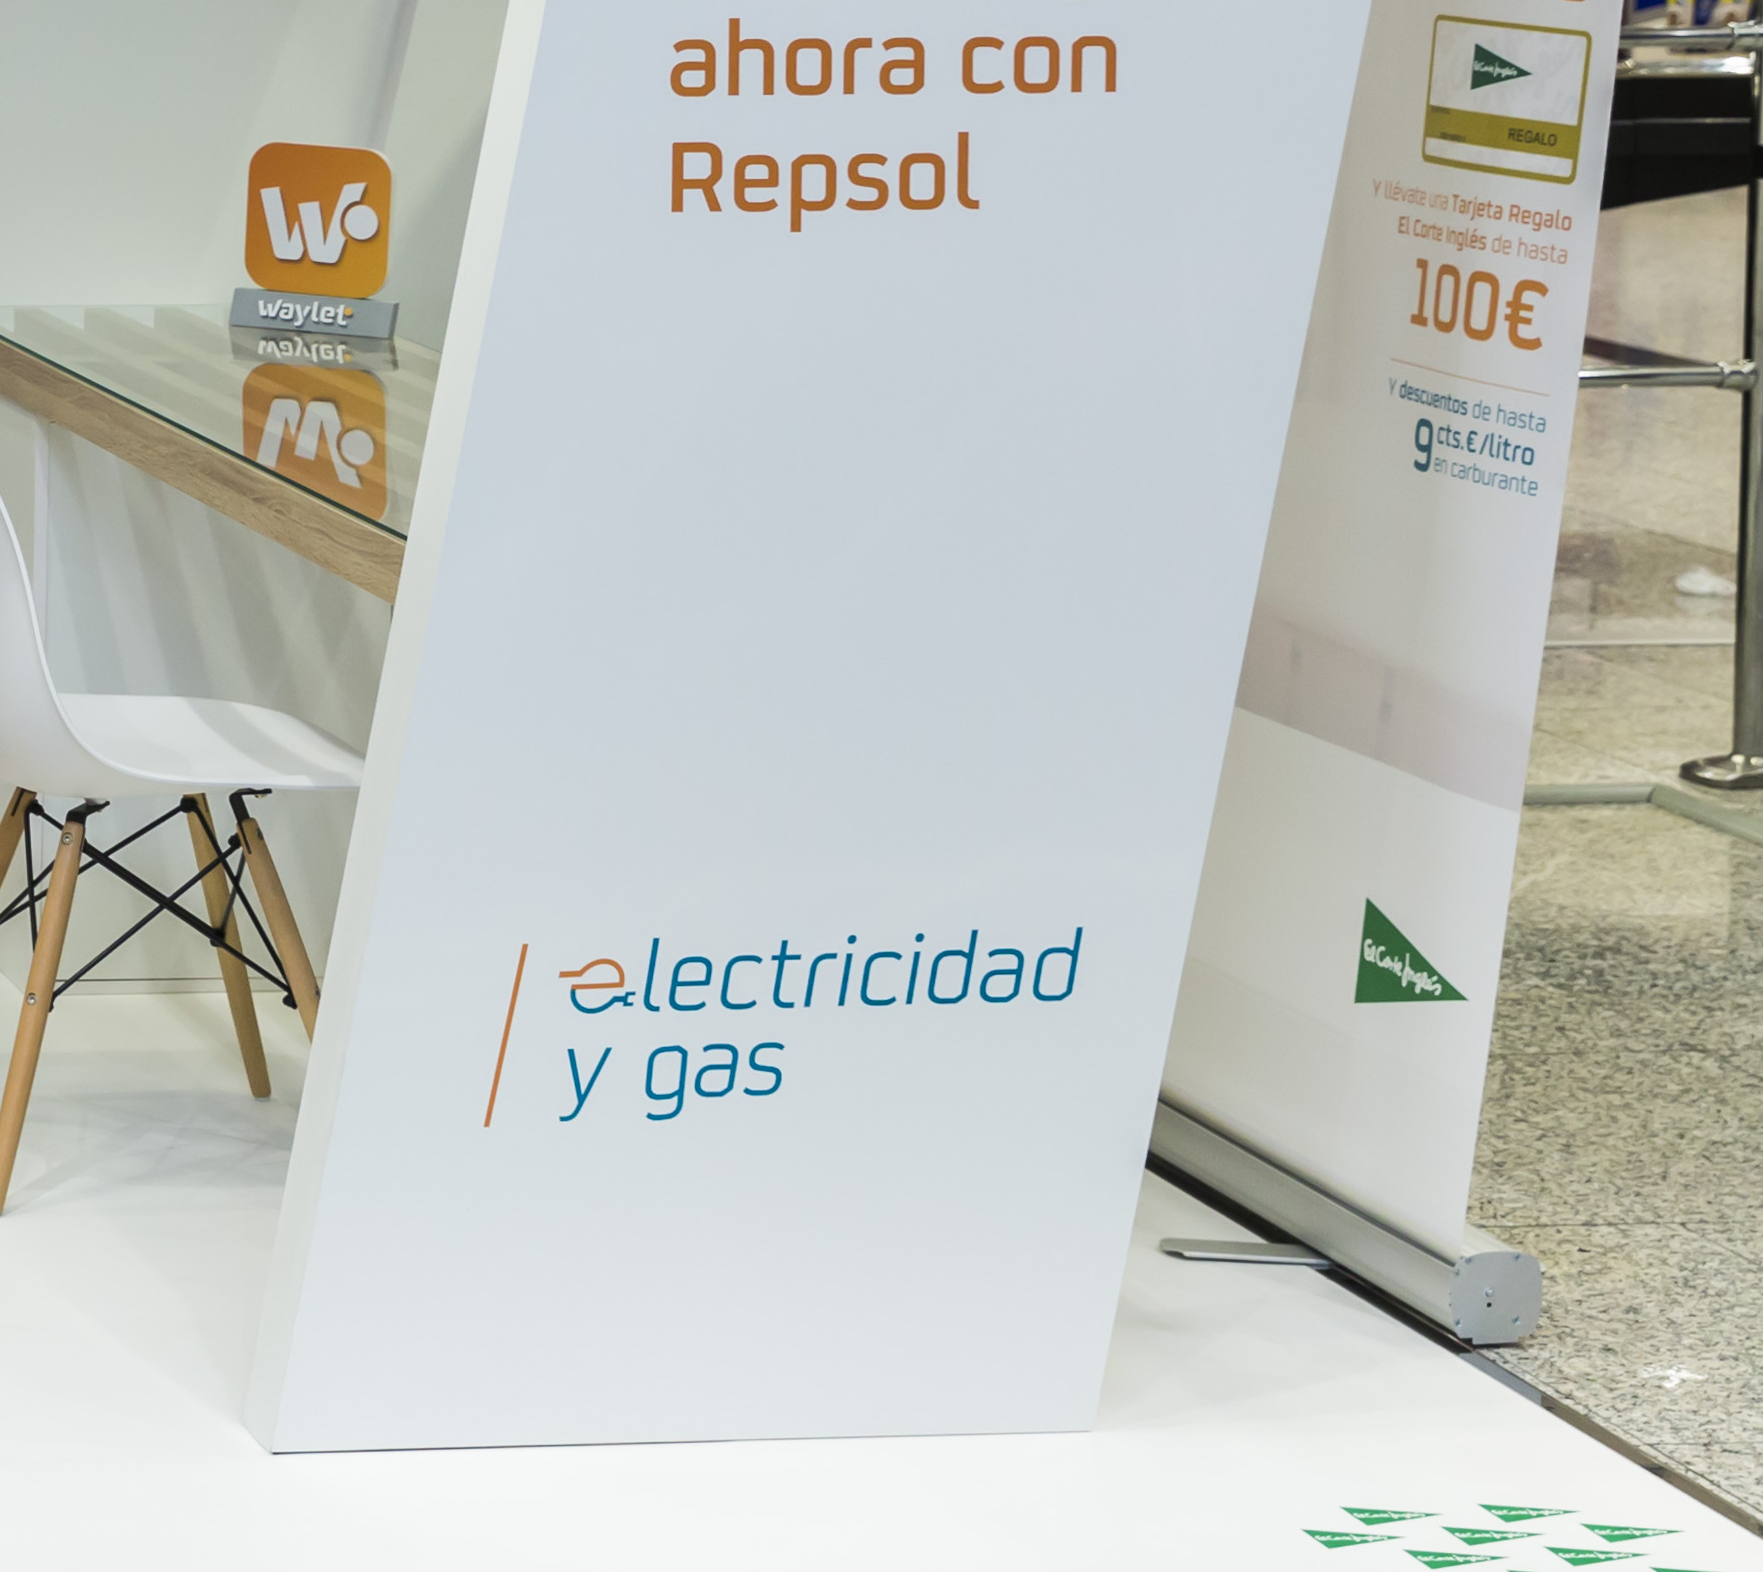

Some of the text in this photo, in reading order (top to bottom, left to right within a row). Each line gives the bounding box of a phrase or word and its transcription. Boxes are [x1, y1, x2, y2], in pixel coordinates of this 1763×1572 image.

[670, 17, 1118, 97] ahora con
[1507, 127, 1559, 148] REGALO
[671, 131, 980, 233] Repsol
[1373, 179, 1573, 232] Y llévate una Tarjeta Regalo
[1398, 216, 1569, 265] El Corte Inglés de hasta
[257, 299, 352, 327] waylet
[1410, 257, 1550, 351] 100€
[1389, 378, 1547, 433] Y descuentos de hasta
[1413, 417, 1434, 472] 9
[1433, 456, 1539, 497] en carburante
[558, 926, 1084, 1014] electricidad
[559, 1041, 786, 1122] y gas
